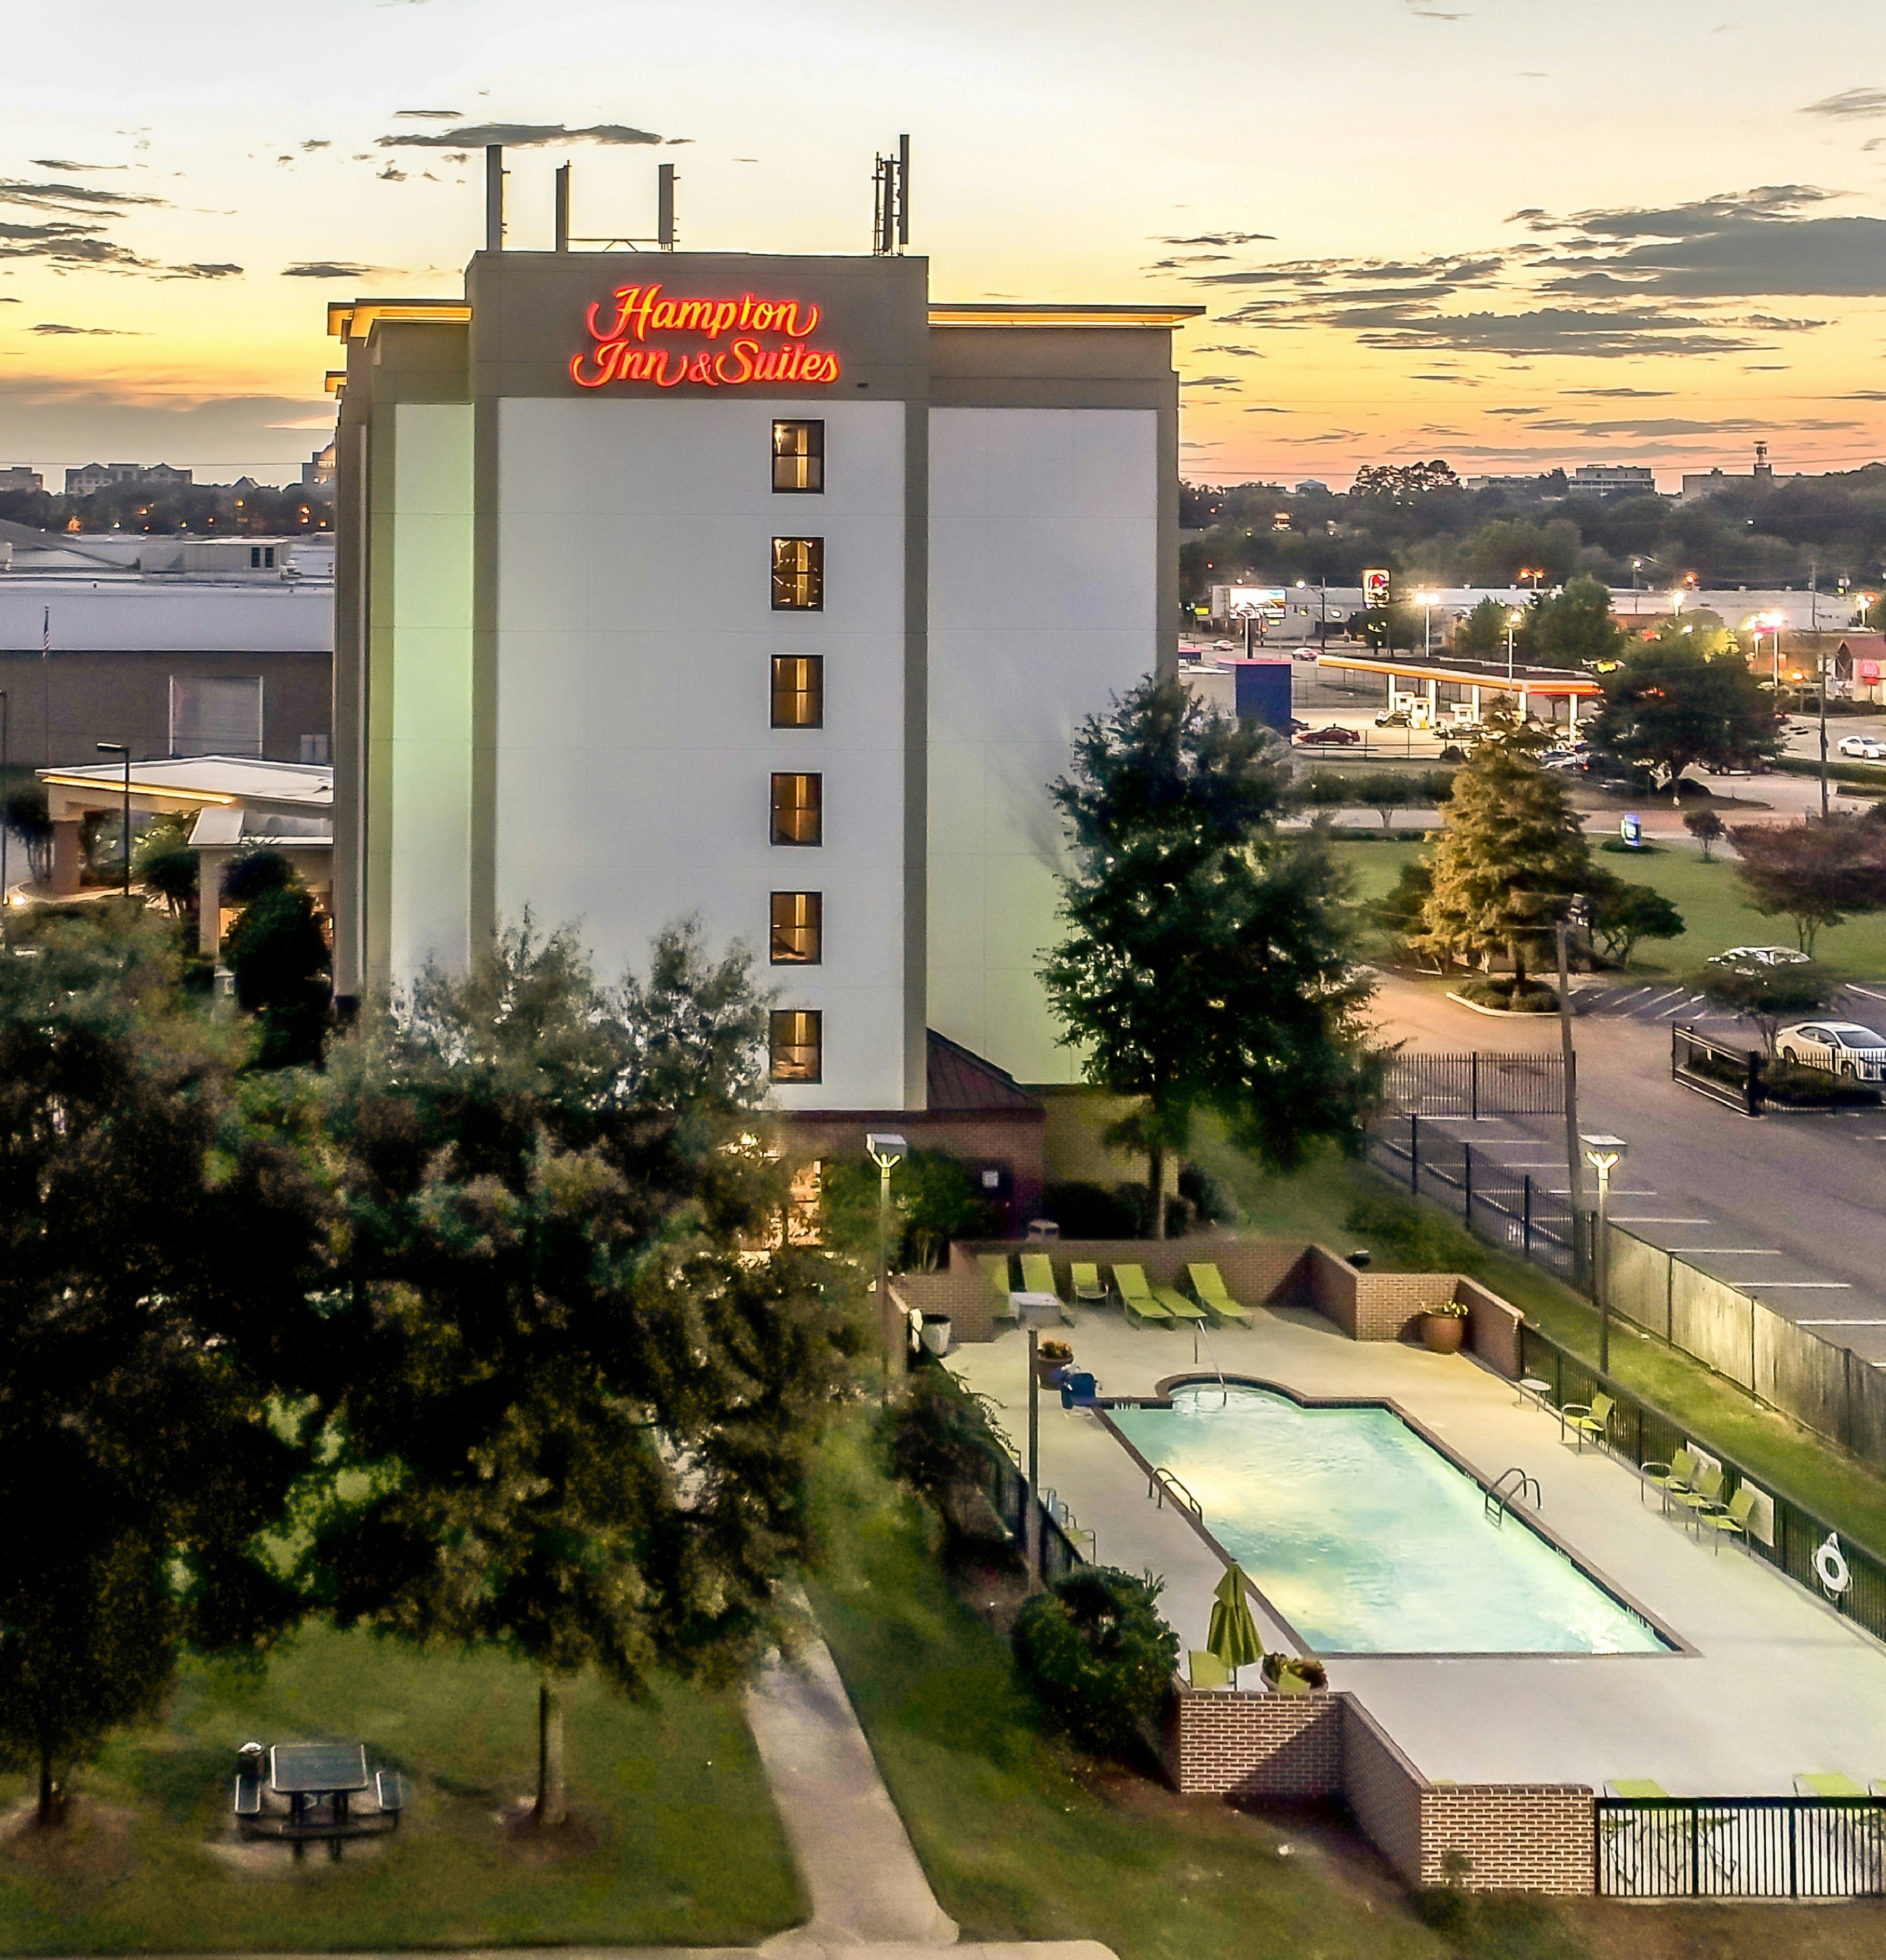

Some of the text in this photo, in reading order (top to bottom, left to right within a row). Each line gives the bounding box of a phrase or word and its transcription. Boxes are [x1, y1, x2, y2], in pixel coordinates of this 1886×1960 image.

[587, 284, 820, 342] Hampton
[570, 339, 689, 387] Inn
[714, 338, 840, 384] Suites
